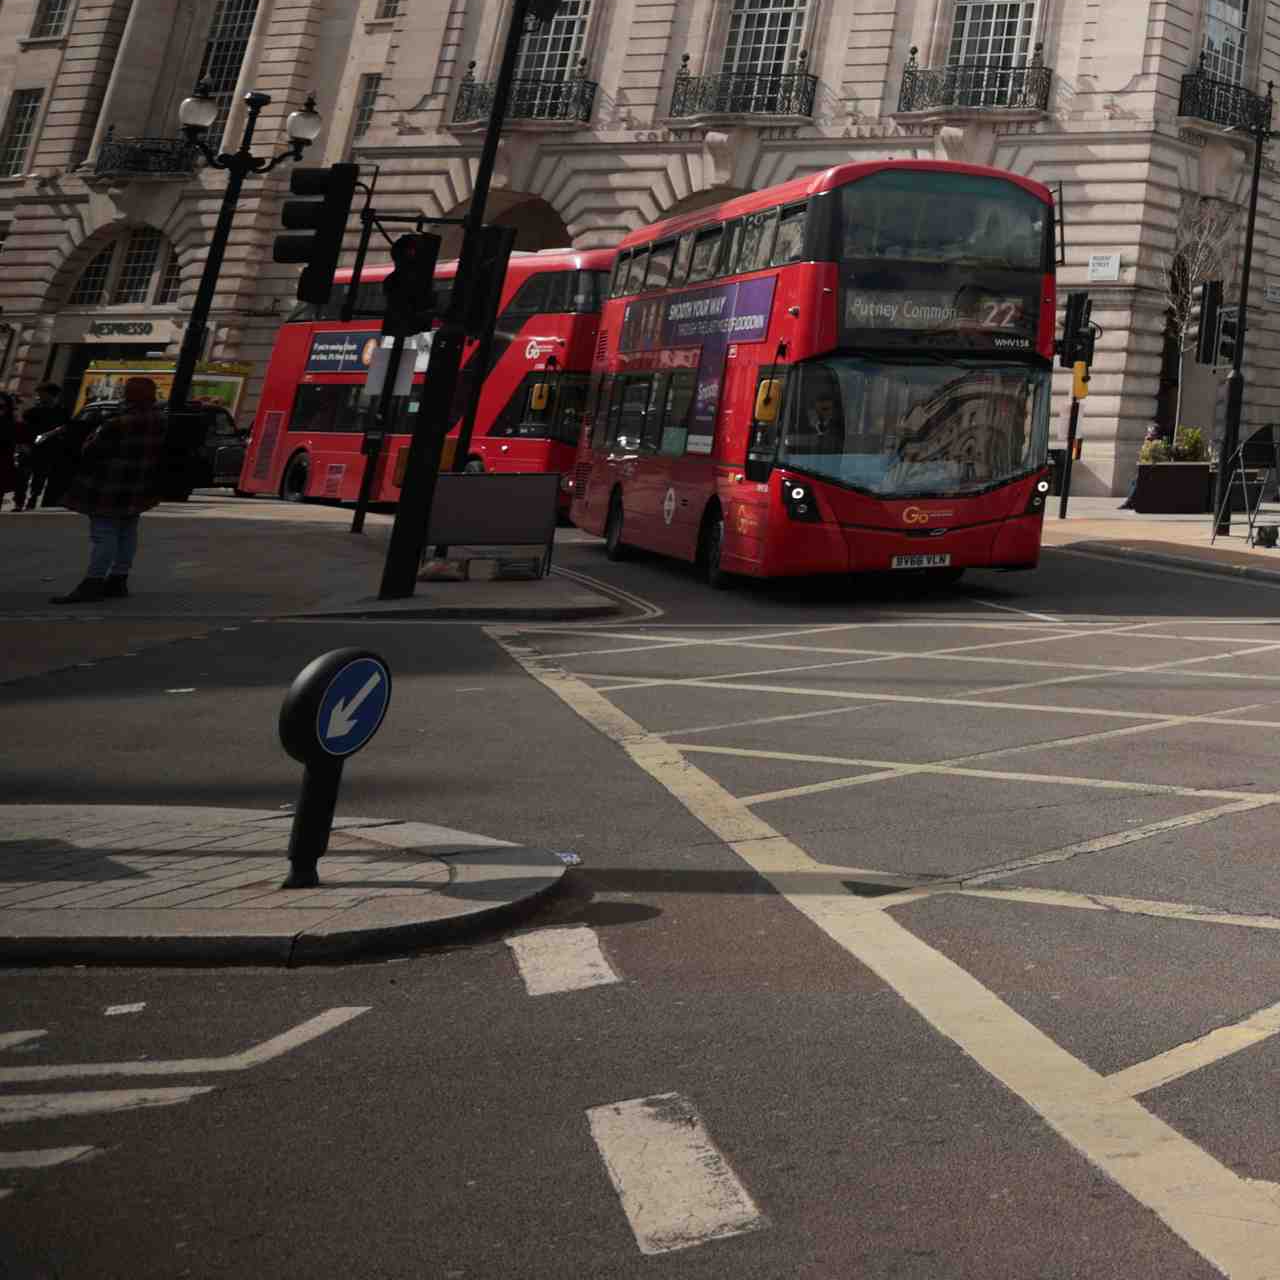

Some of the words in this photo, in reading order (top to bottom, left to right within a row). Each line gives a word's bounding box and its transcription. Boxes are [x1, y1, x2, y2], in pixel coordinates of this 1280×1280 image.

[851, 295, 897, 320] Putney
[903, 300, 957, 321] Common
[980, 302, 1016, 327] 22
[902, 506, 928, 524] Go
